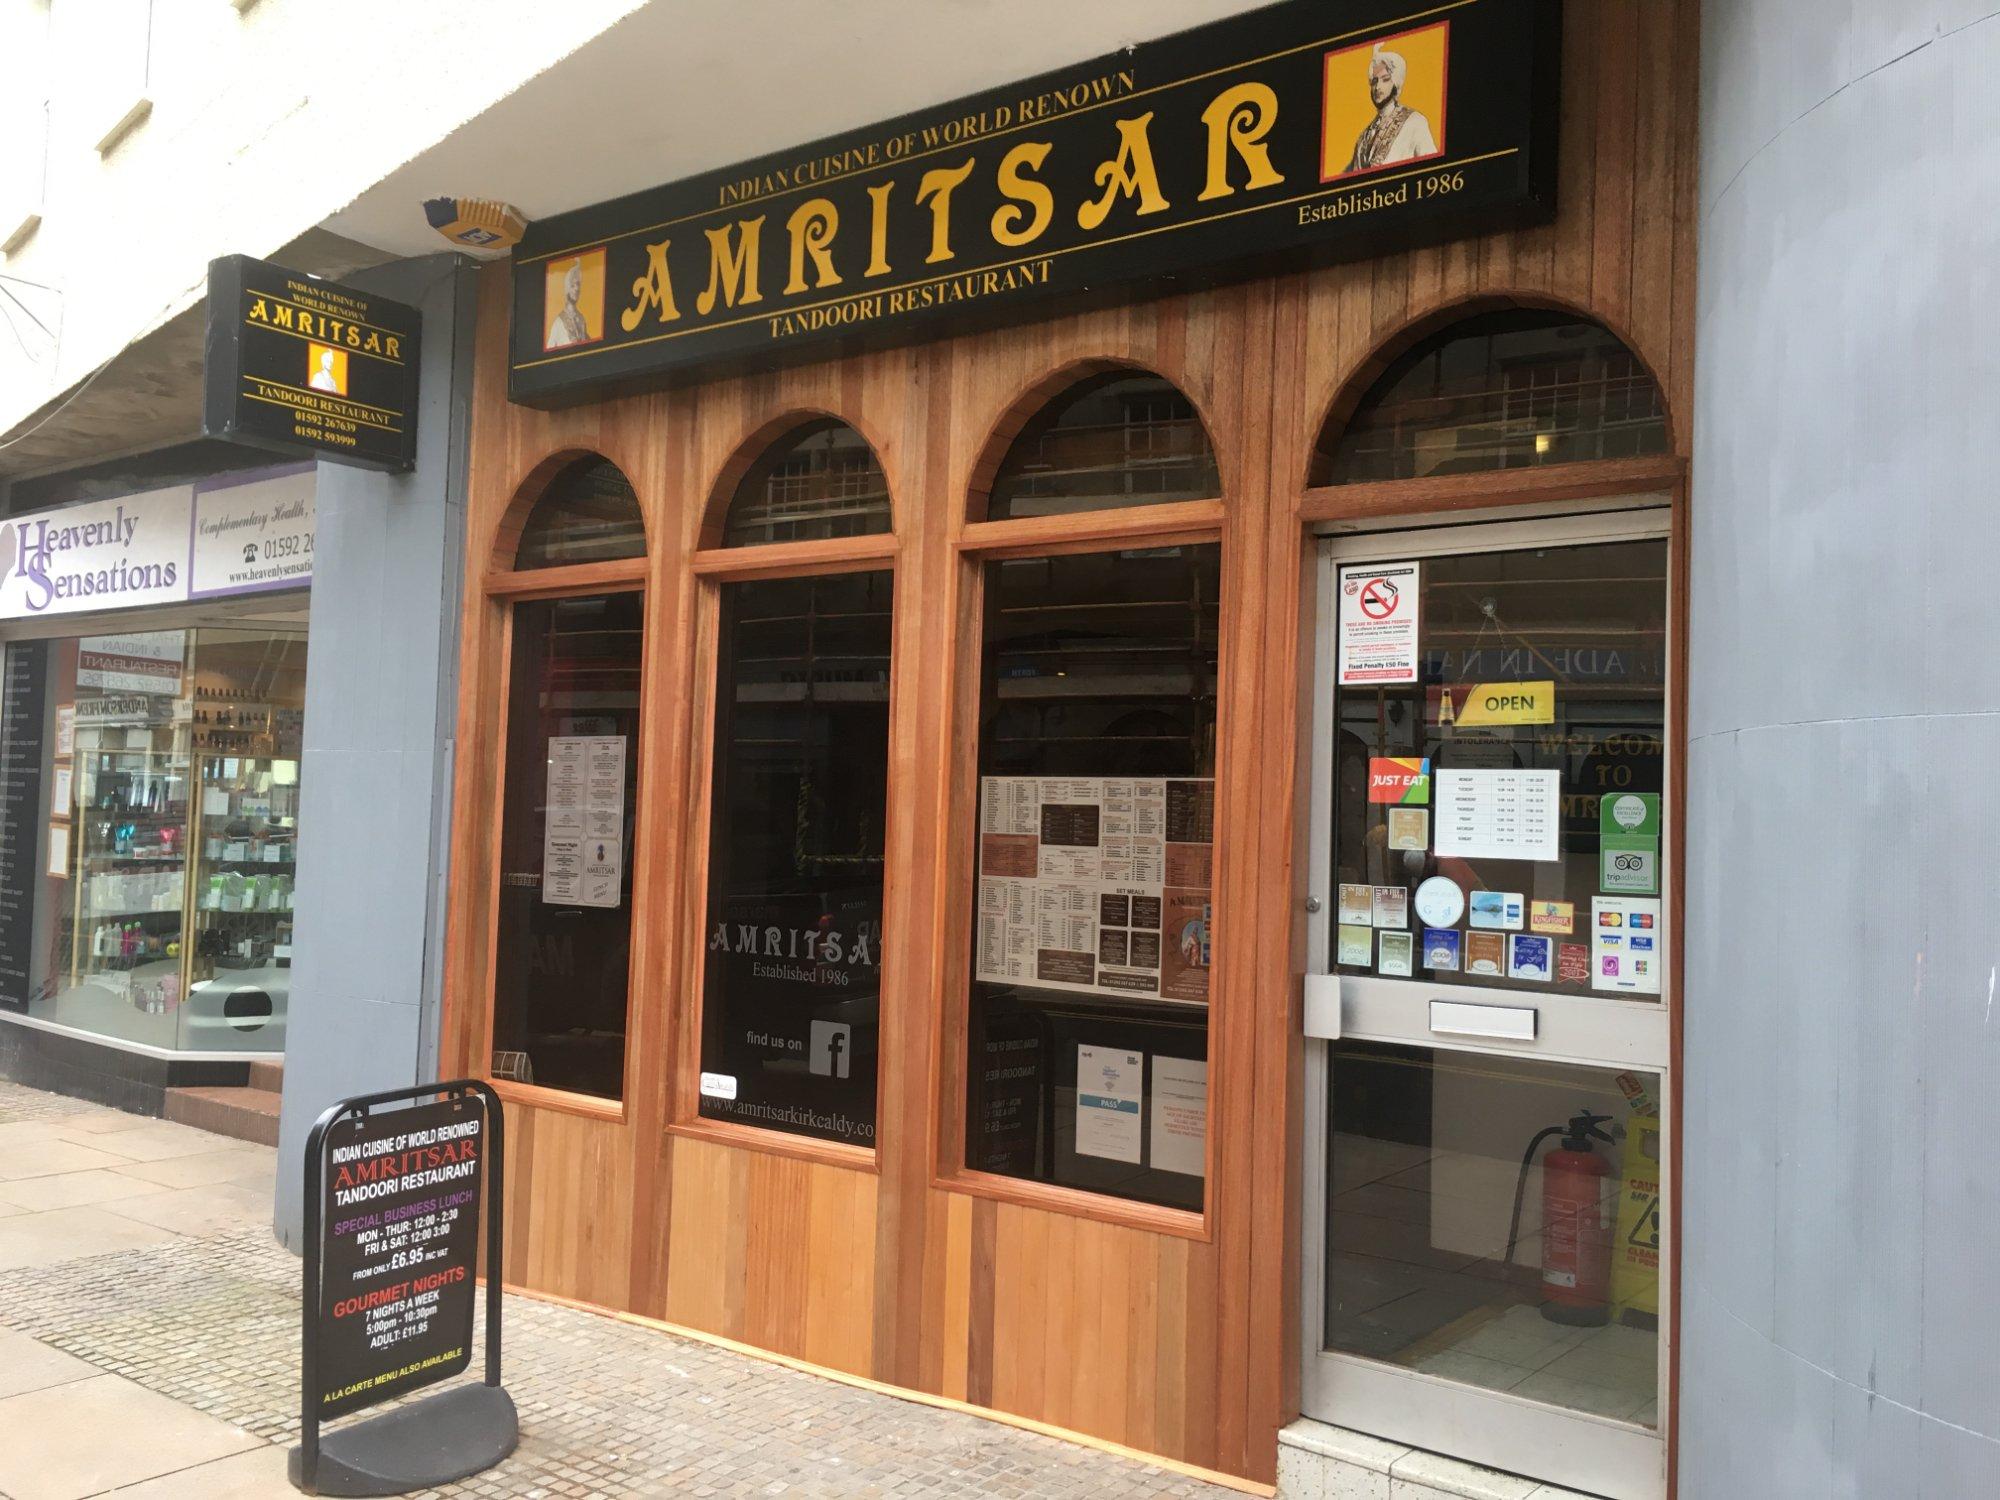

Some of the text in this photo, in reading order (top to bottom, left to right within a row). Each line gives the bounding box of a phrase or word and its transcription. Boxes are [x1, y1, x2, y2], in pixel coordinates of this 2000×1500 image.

[720, 69, 1136, 206] INDIAN CUISINE OF WORLD RENOWN
[621, 81, 1286, 332] AMRITSAR
[1298, 170, 1465, 226] Established 1986
[288, 280, 368, 310] INDIAN CUISINE OF
[291, 294, 366, 322] WORLD RENOWN
[769, 260, 1055, 339] TANDOORI RESTAURANT
[249, 299, 400, 358] AMRITSAR
[258, 384, 391, 425] TANDOORI RESTAURANT
[295, 411, 356, 433] 01592 267639
[295, 426, 356, 446] 01592 593999
[199, 499, 309, 537] Complementary Health,
[15, 506, 140, 577] Heavenly
[264, 535, 301, 560] 01592
[25, 552, 178, 611] Sensations
[1348, 662, 1363, 670] Fixed
[1364, 661, 1384, 670] Penalty
[1485, 695, 1535, 712] OPEN
[1372, 774, 1425, 787] JUST EAT
[1606, 873, 1648, 882] tripadvisor
[710, 922, 883, 966] AMRITSA
[753, 962, 849, 986] Established 1986
[747, 1031, 802, 1050] find us on
[1100, 1099, 1118, 1109] PASS
[333, 1119, 479, 1164] INDIAN CUISINE OF WORLD RENOWNED
[334, 1138, 478, 1189] AMRITSAR
[335, 1160, 476, 1207] TANDOORI RESTAURANT
[334, 1189, 473, 1237] SPECIAL BUSINESS LUNCH
[357, 1230, 378, 1245] MON
[385, 1220, 412, 1238] THUR:
[414, 1213, 436, 1228] 12:00
[441, 1208, 458, 1222] 2:30
[364, 1222, 450, 1257] FRI & SAT: 12:00 3:00
[352, 1268, 372, 1281] FROM
[373, 1262, 390, 1276] ONLY
[391, 1246, 424, 1270] £6.95
[437, 1247, 449, 1258] VAT
[333, 1266, 465, 1318] GOURMET NIGHTS
[365, 1289, 440, 1322] 7 NIGHTS A WEEK
[366, 1318, 397, 1336] 5:00pm
[404, 1304, 438, 1327] 10:30pm
[370, 1321, 428, 1350] ADULT: £11.95
[323, 1348, 463, 1404] A LA CARTE MENU ALSO AVAILABLE
